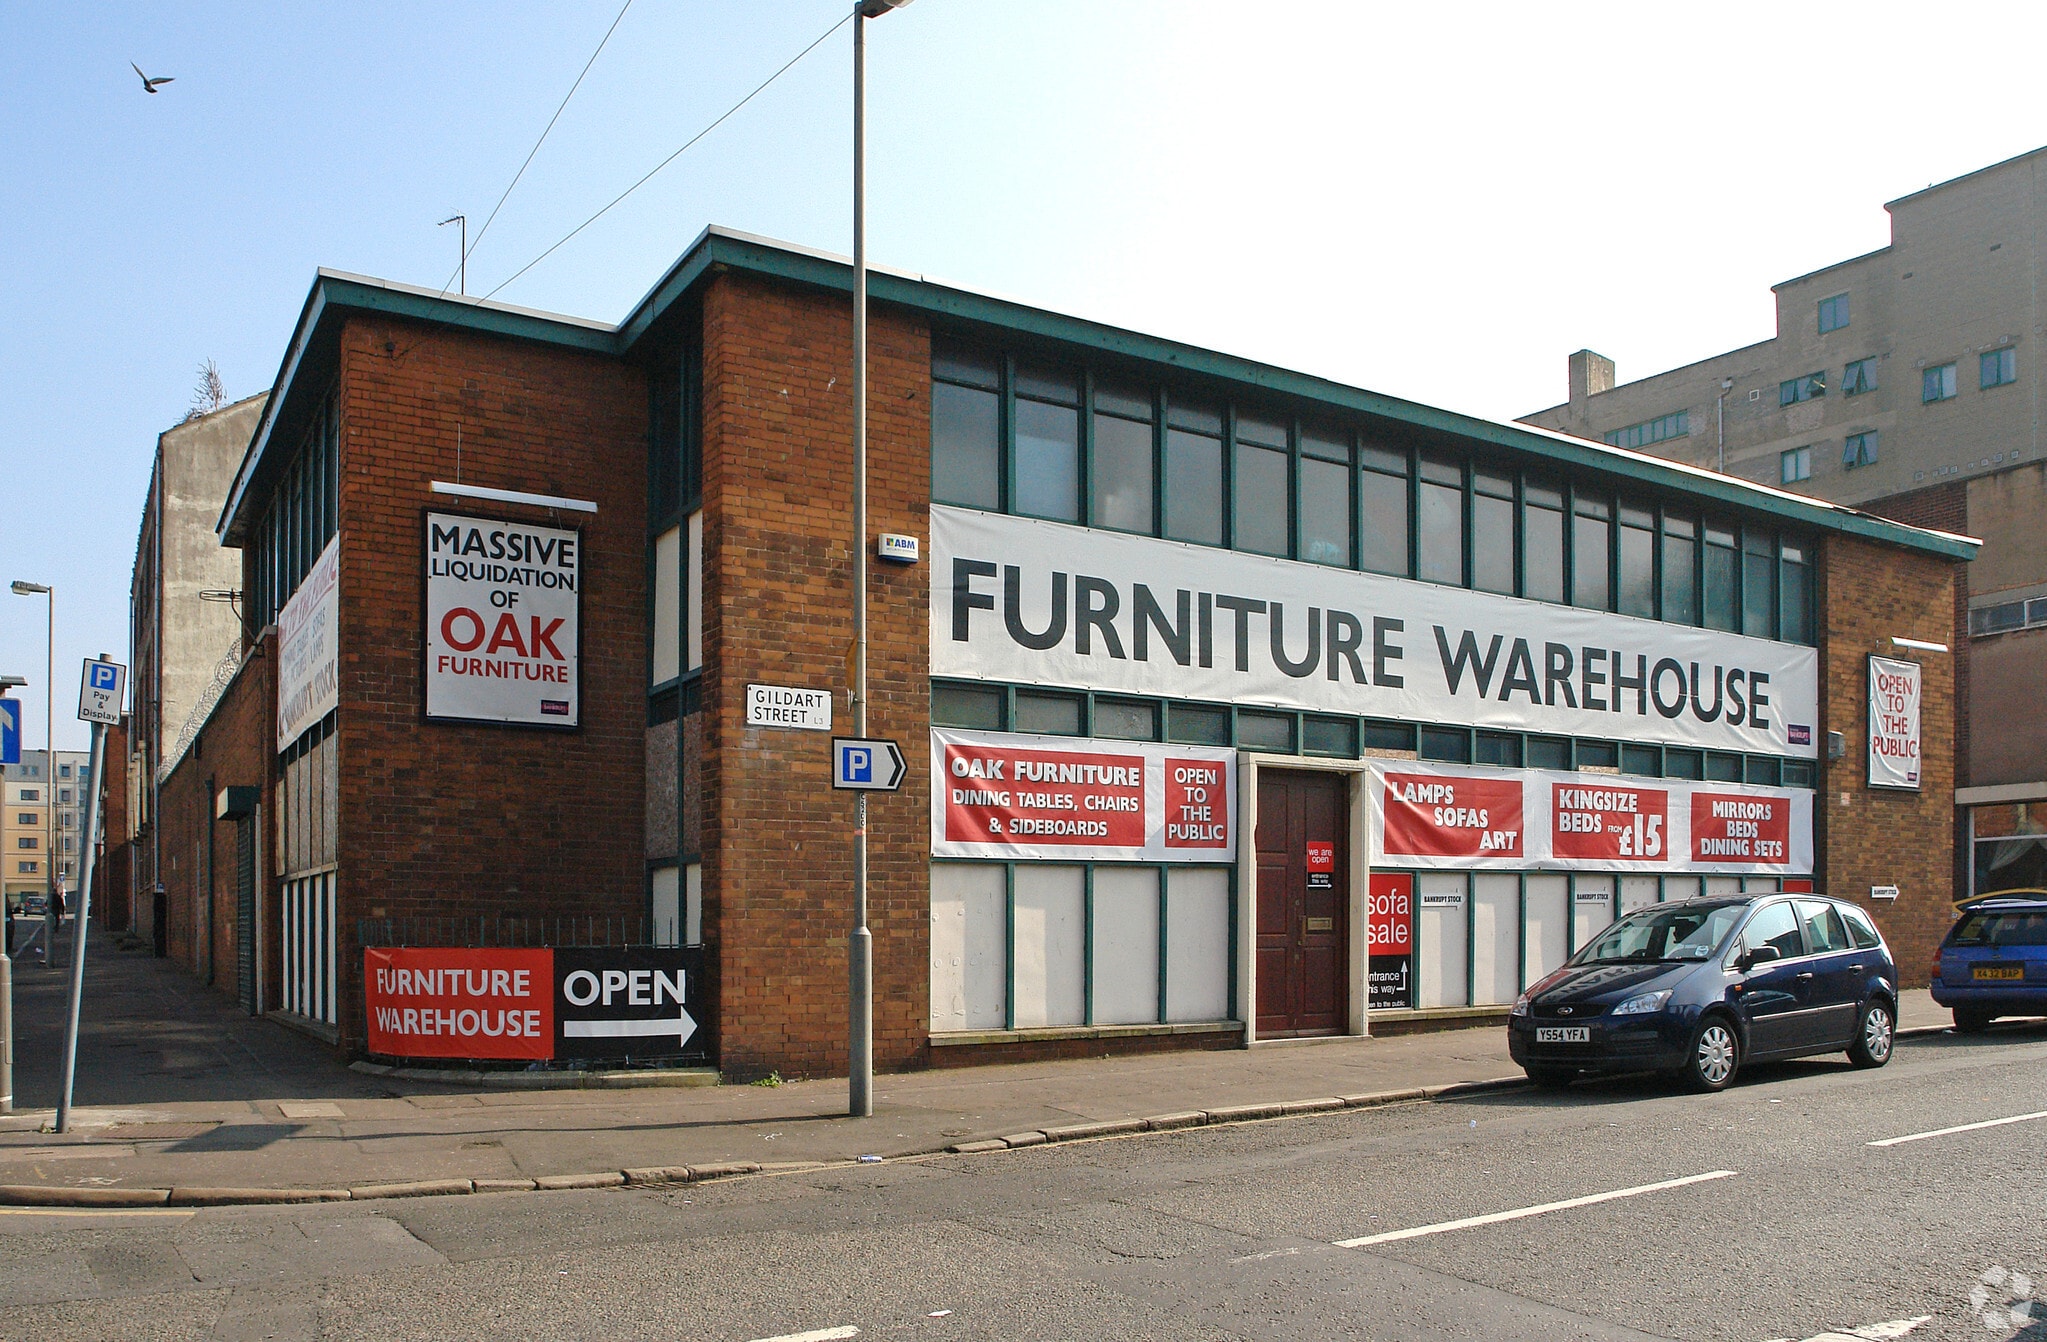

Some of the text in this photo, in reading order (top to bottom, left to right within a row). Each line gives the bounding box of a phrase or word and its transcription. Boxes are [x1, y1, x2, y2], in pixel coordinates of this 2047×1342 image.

[432, 523, 574, 568] MASSIVE
[894, 539, 915, 549] ABM
[432, 558, 574, 591] LIQUIDATION
[490, 590, 519, 608] OF
[441, 607, 566, 660] OAK
[952, 557, 1769, 730] FURNITURE WAREHOUSE
[95, 667, 113, 686] P
[438, 655, 568, 683] FURNITURE
[1878, 673, 1912, 695] OPEN
[93, 691, 110, 701] Pay
[97, 701, 104, 709] &
[755, 690, 823, 708] GILDART
[1886, 694, 1904, 713] TO
[83, 708, 117, 721] Display
[754, 706, 824, 725] STREET L3
[1883, 714, 1908, 735] THE
[1873, 736, 1916, 758] PUBLIC
[849, 750, 868, 779] P
[951, 757, 1140, 787] OAK FURNITURE
[1174, 767, 1216, 785] OPEN
[952, 788, 1139, 812] DINING TABLES, CHAIRS
[1184, 786, 1207, 803] TO
[1391, 781, 1454, 805] LAMPS
[1559, 789, 1638, 812] KINGSIZE
[1180, 805, 1211, 822] THE
[1434, 807, 1488, 828] SOFAS
[1712, 800, 1772, 821] MIRRORS
[988, 817, 1108, 837] & SIDEBOARDS
[1168, 822, 1224, 840] PUBLIC
[1559, 812, 1623, 834] BEDS FROM
[1726, 820, 1759, 838] BEDS
[1479, 830, 1517, 850] ART
[1619, 813, 1663, 857] £15
[1701, 837, 1783, 857] DINING SETS
[1311, 856, 1329, 864] open
[1424, 895, 1461, 903] BANKRUPT STOCK
[1367, 917, 1408, 944] sale
[376, 968, 531, 997] FURNITURE
[1368, 971, 1400, 982] ntrance
[1977, 968, 2019, 978] X432 BAP
[563, 969, 686, 1007] OPEN
[1380, 985, 1397, 995] way
[1391, 999, 1405, 1007] public
[375, 1006, 541, 1037] WAREHOUSE
[1539, 1028, 1585, 1041] YS54 YFA
